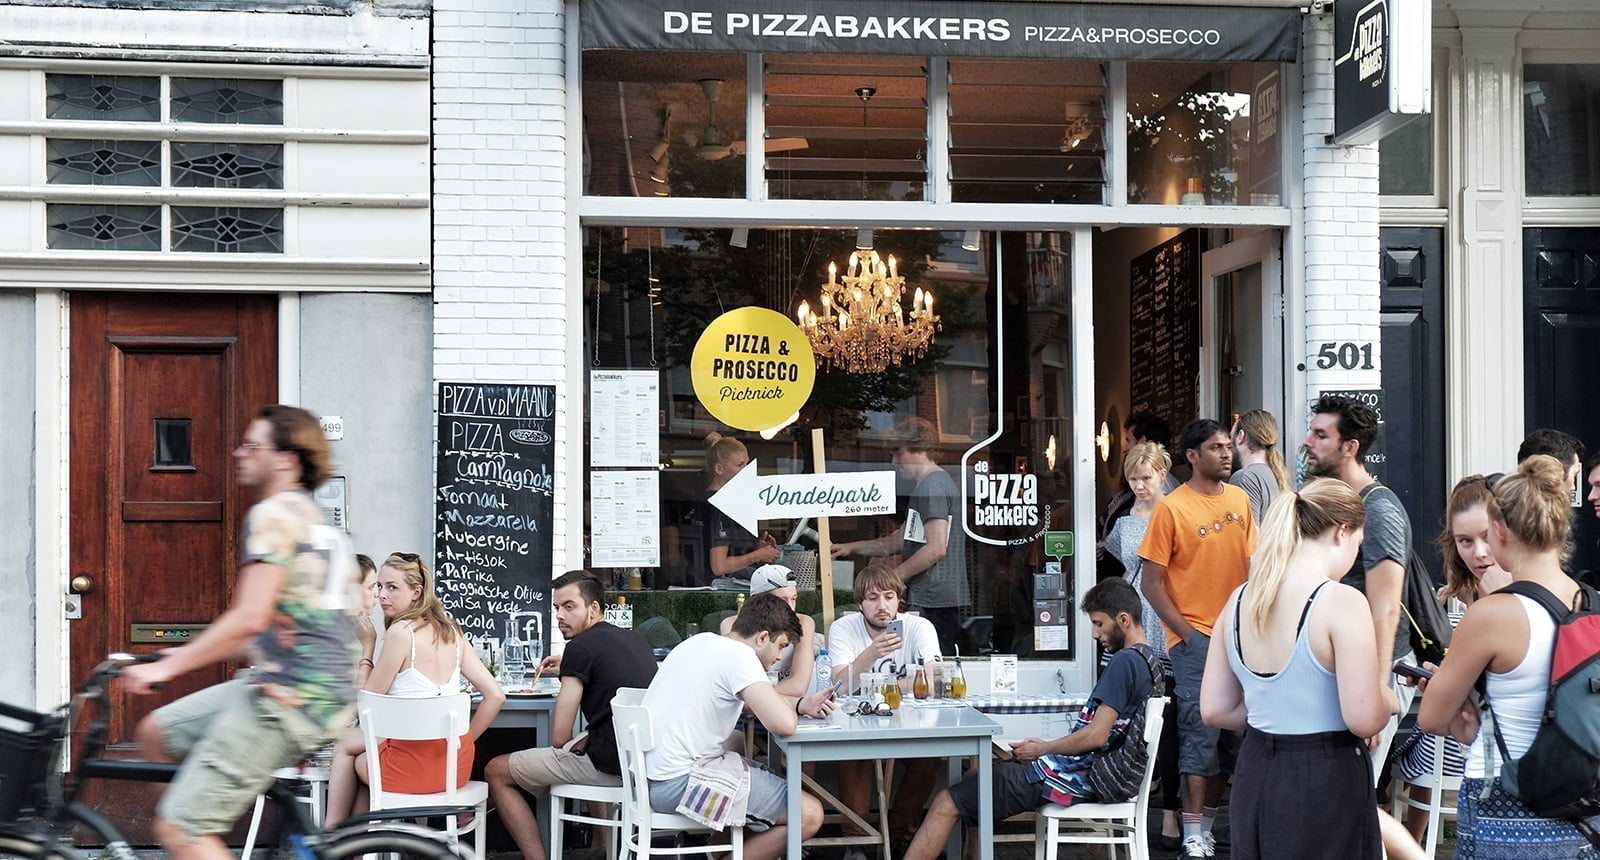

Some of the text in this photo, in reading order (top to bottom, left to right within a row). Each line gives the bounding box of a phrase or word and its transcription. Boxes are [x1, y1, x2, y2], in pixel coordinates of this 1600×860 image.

[663, 11, 1221, 45] DE PIZZABAKKERS PIZZA&PROSECCO
[725, 333, 790, 356] PIZZA &
[1316, 341, 1375, 371] 501
[712, 358, 799, 382] PROSECCO
[443, 385, 486, 416] PIZZA
[719, 385, 785, 402] Picknick
[451, 421, 505, 452] PIZZA
[974, 460, 989, 473] de
[758, 483, 882, 509] Vondelpark
[845, 505, 862, 514] 260
[974, 504, 1039, 527] bakkers
[444, 524, 529, 555] Aubergine
[1007, 537, 1029, 547] PIZZA
[1029, 535, 1035, 543] &
[446, 545, 508, 569] Artisjok
[620, 611, 630, 621] &
